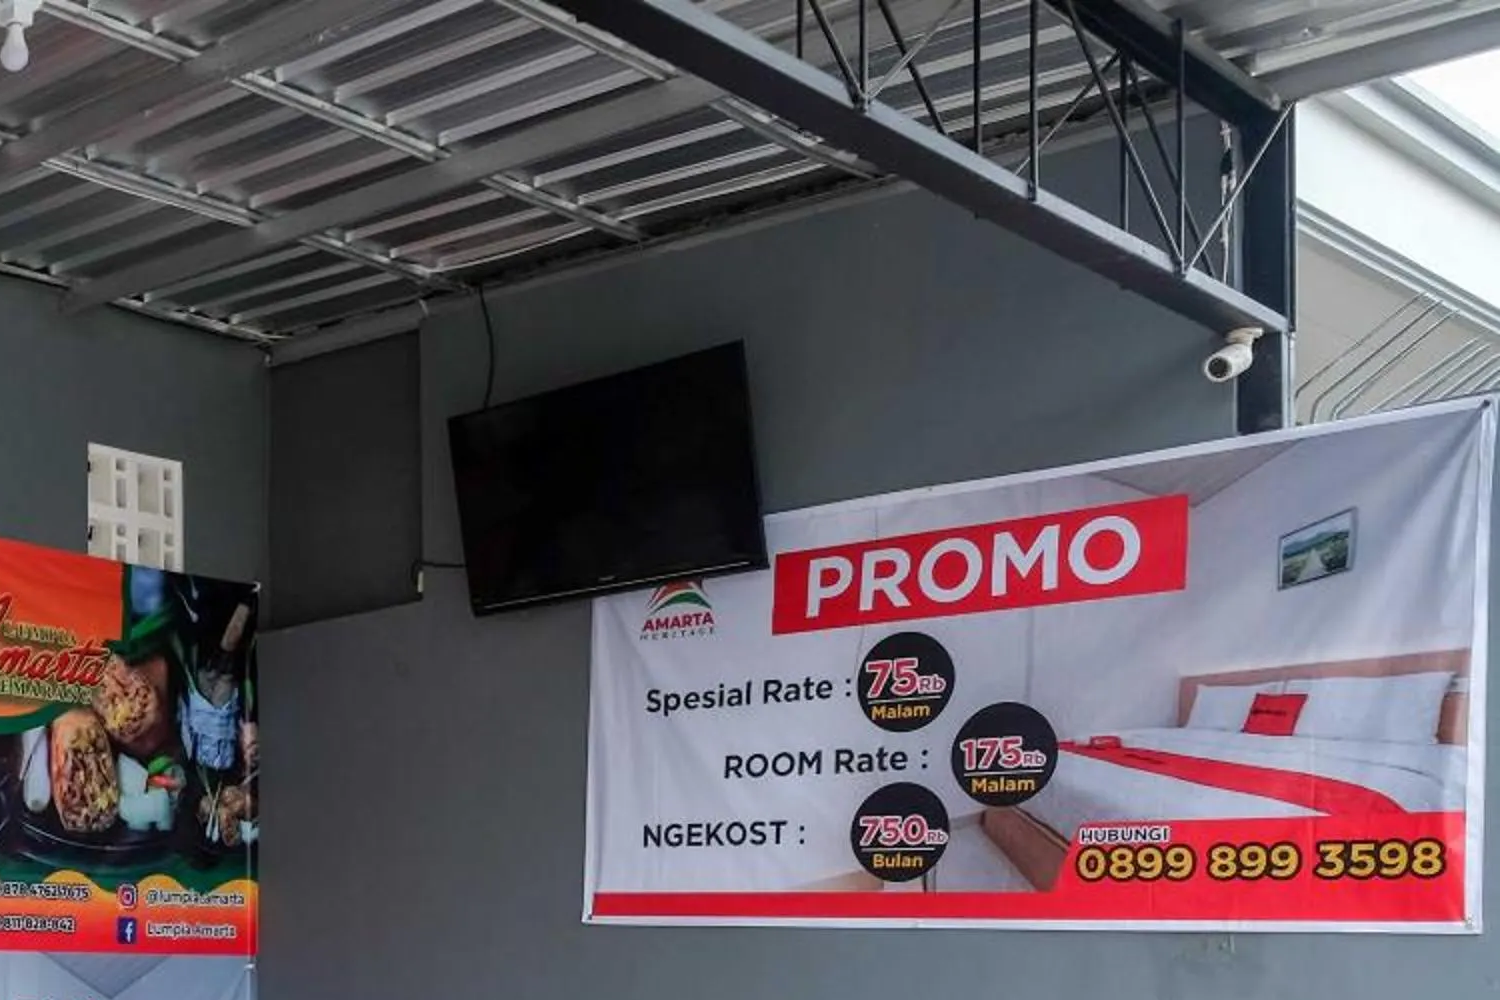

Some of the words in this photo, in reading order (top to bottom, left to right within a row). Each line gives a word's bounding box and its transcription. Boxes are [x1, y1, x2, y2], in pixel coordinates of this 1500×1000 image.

[805, 515, 1141, 619] PROMO
[642, 612, 714, 632] AMARTA
[639, 627, 714, 641] HERITAGE
[646, 680, 752, 717] Spesial
[763, 677, 833, 704] Rate
[870, 703, 931, 721] Malam
[724, 751, 822, 779] ROOM
[834, 747, 909, 774] Rate
[971, 777, 1036, 794] Malam
[643, 820, 788, 848] NGEKOST
[1079, 826, 1171, 844] HUBUNGI
[873, 853, 923, 869] Bulan
[1077, 844, 1196, 881] 0899
[1208, 843, 1302, 880] 899
[1316, 839, 1444, 879] 3598
